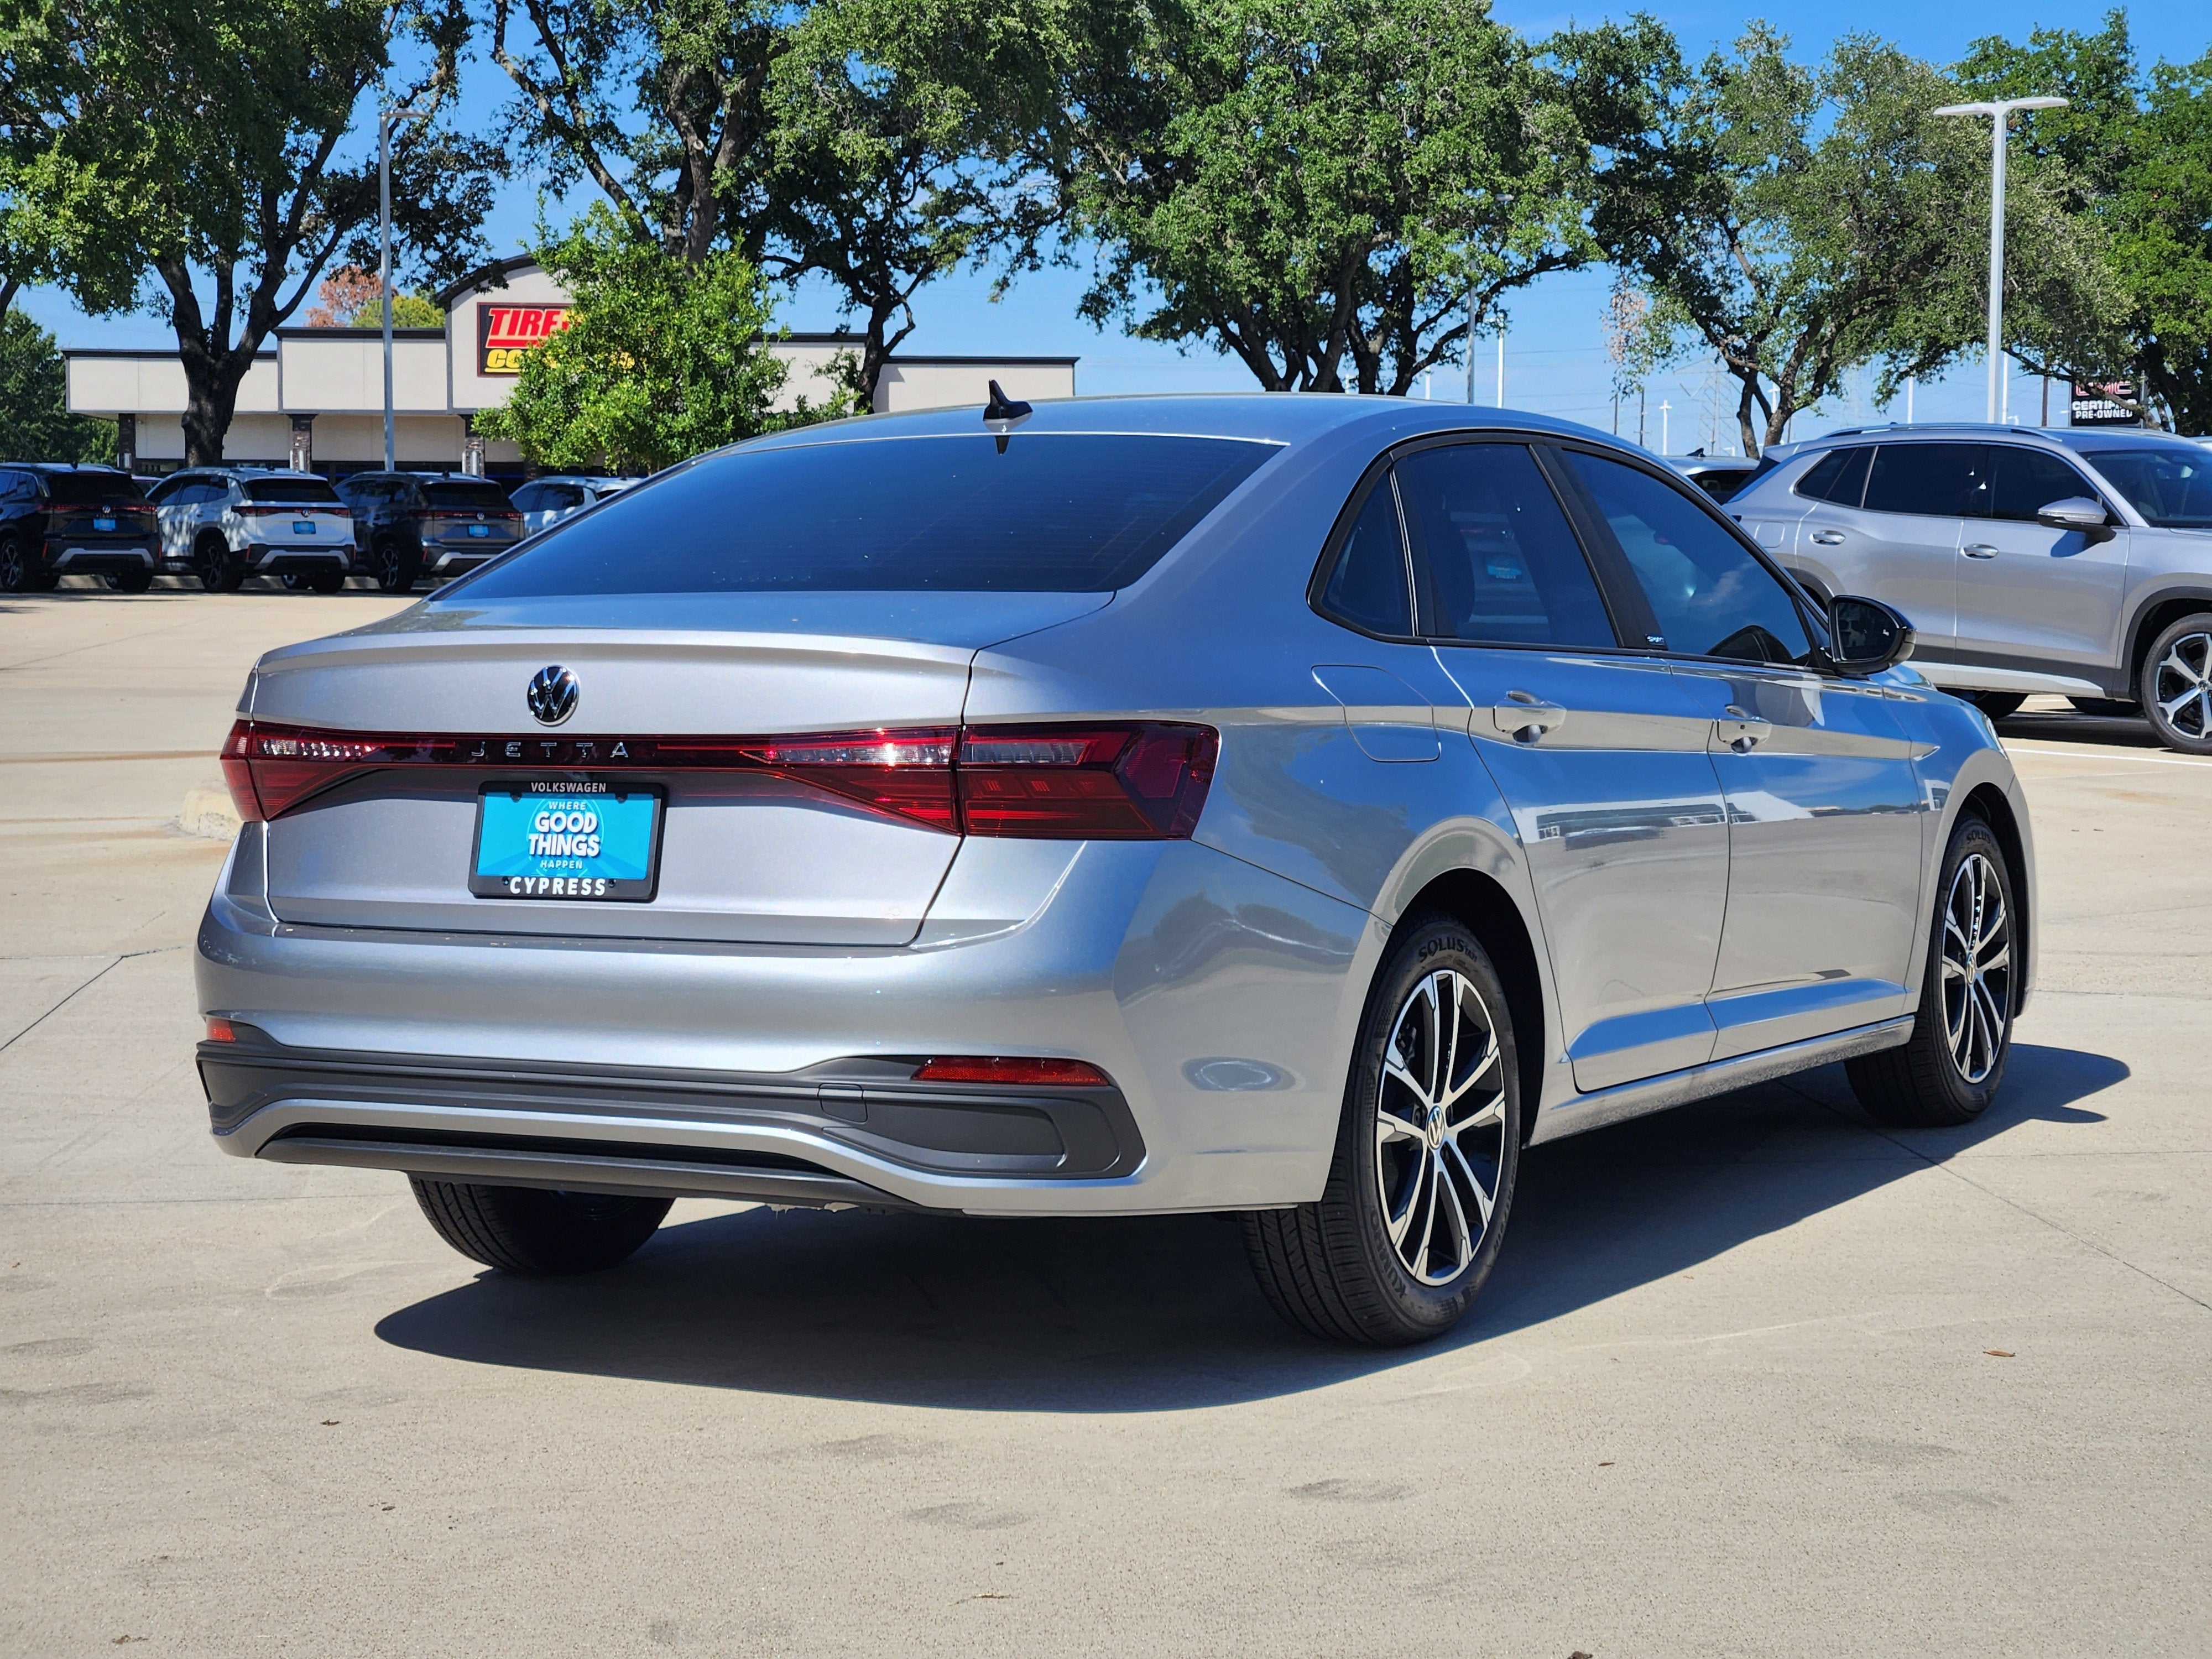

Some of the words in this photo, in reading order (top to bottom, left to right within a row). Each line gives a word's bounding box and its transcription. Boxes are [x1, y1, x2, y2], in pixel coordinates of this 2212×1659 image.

[2075, 409, 2133, 419] PRE-OWNED
[471, 742, 629, 758] JETTA
[531, 782, 606, 792] VOLKSWAGEN
[549, 801, 586, 810] WHERE
[534, 811, 598, 833] GOOD
[529, 833, 601, 857] THINGS
[540, 860, 583, 869] HAPPEN
[509, 877, 606, 896] CYPRESS
[1418, 937, 1464, 963] SOLUS
